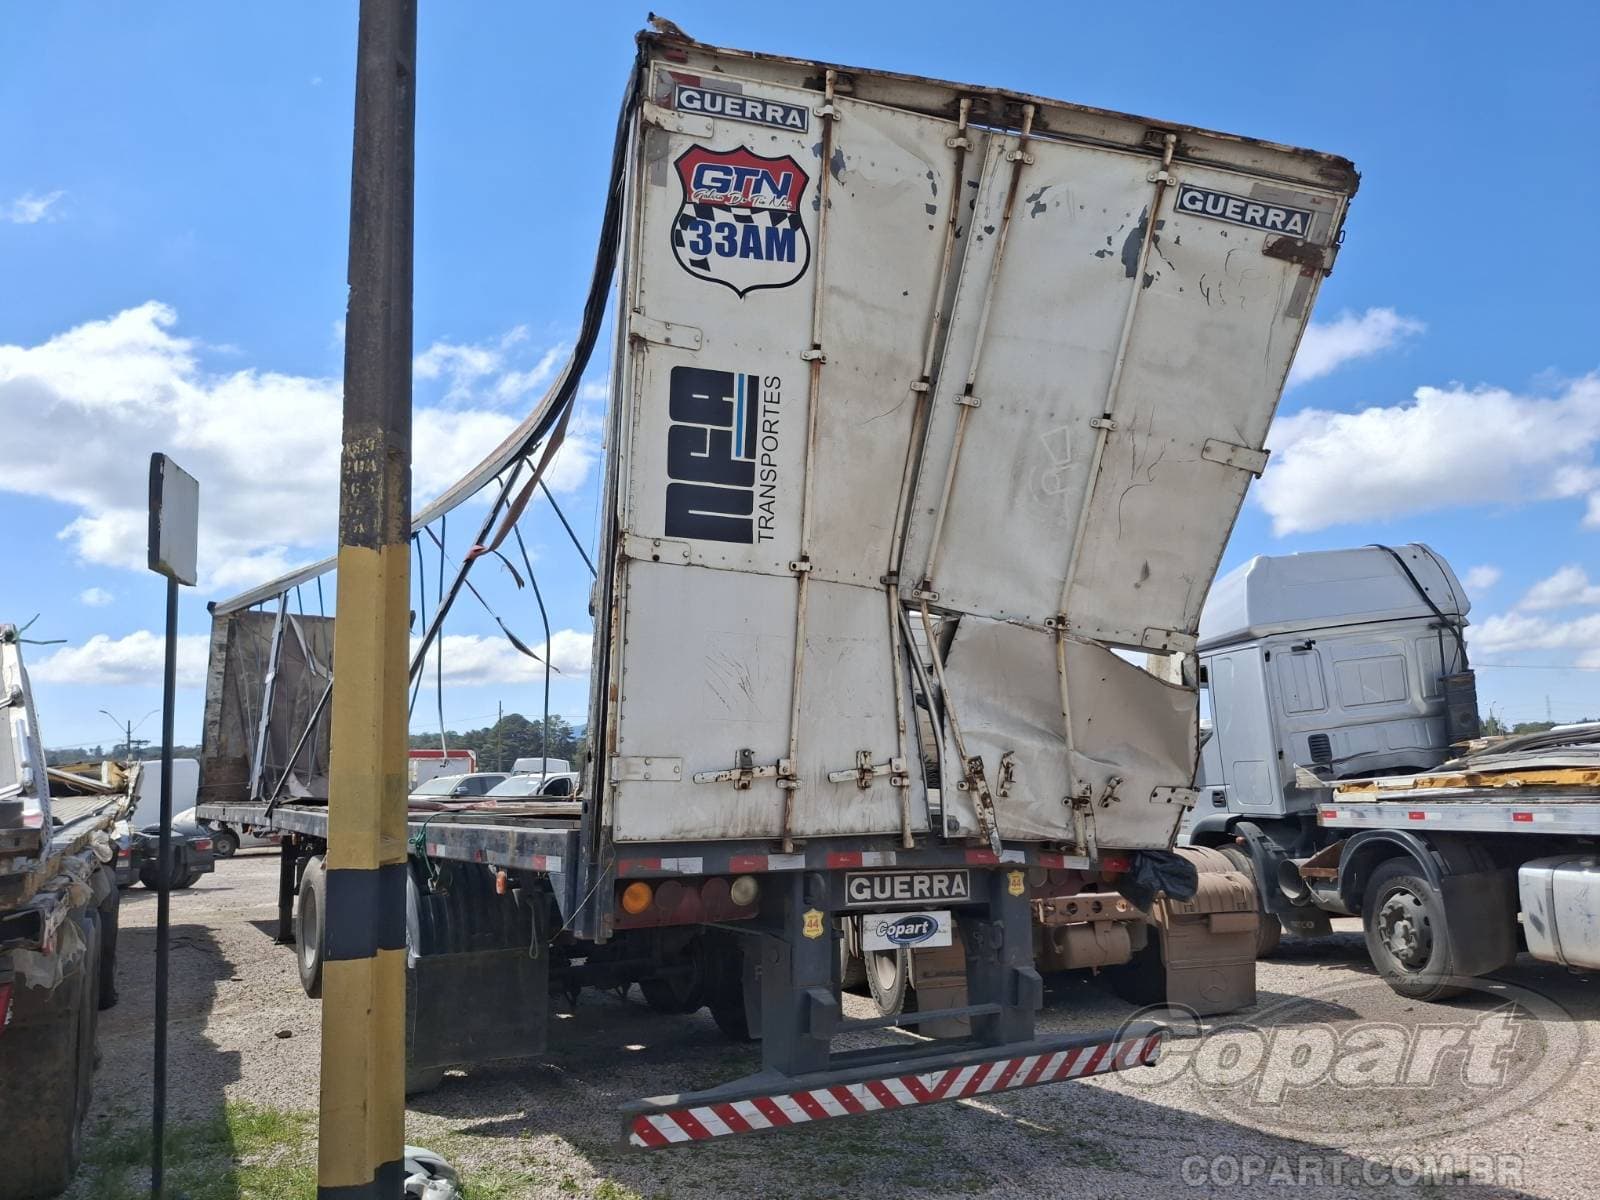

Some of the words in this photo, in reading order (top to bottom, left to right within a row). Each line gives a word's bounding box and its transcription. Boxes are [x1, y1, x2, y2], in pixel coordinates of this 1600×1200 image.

[679, 89, 803, 129] GUERRA
[692, 163, 793, 199] GTN
[1181, 190, 1303, 235] GUERRA
[688, 220, 796, 263] 33AM
[757, 375, 782, 544] TRANSPORTES
[849, 873, 967, 900] GUERRA
[876, 921, 929, 939] Copart
